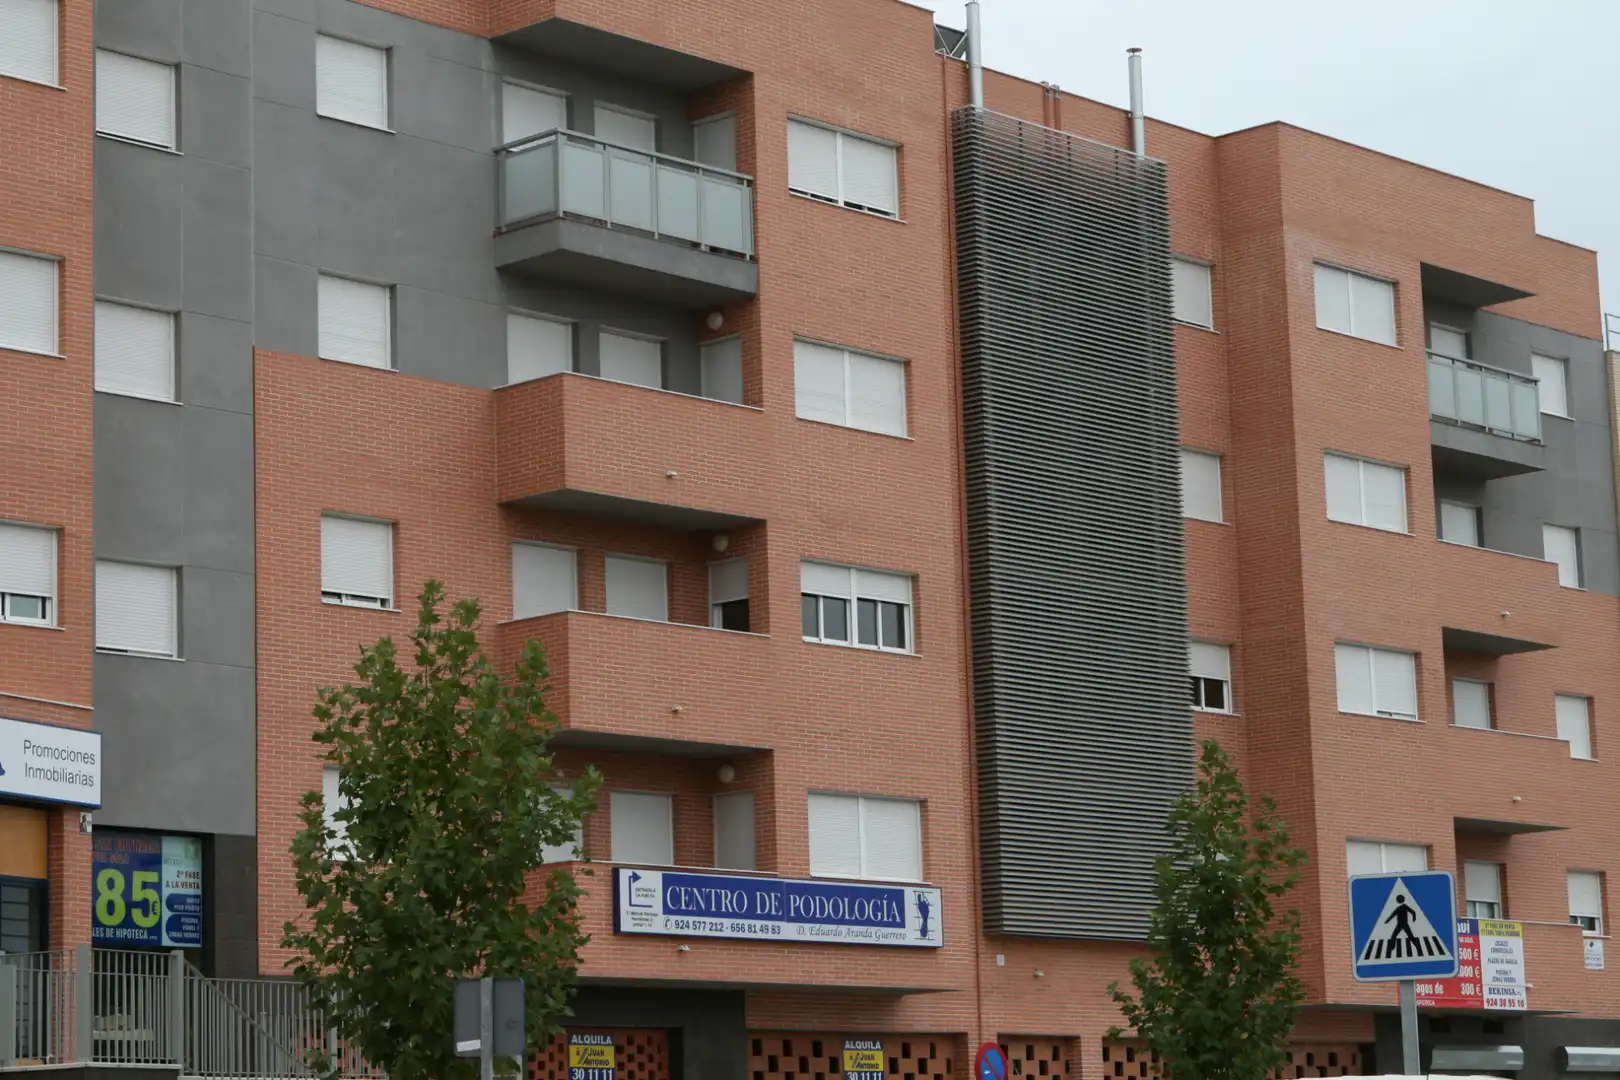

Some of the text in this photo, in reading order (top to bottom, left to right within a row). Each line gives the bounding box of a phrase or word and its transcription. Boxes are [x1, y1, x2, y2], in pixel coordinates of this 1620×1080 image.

[23, 740, 95, 765] Promociones
[24, 762, 94, 787] Inmobiliarias
[185, 871, 200, 880] FASE
[181, 881, 200, 890] VENTA
[666, 886, 900, 922] CENTRO DE PODOLOGÍA
[92, 927, 104, 936] LES
[106, 928, 114, 937] DE
[116, 928, 148, 939] HIPOTECA
[675, 920, 690, 930] 924
[692, 920, 706, 931] 577
[709, 922, 724, 932] 212
[731, 923, 745, 933] 656
[748, 924, 757, 934] 81
[759, 924, 769, 934] 49
[771, 925, 781, 935] 83
[797, 926, 907, 942] D. Eduardo Aranda Guerrero
[1474, 949, 1479, 960] €
[1475, 966, 1480, 978] €
[1416, 981, 1481, 996] agos de 300 €
[1488, 987, 1516, 996] BEKINSA
[1486, 998, 1497, 1007] 924
[572, 1034, 612, 1045] ALQUILA
[845, 1040, 881, 1049] ALQUILA
[572, 1068, 612, 1080] 30 11 11
